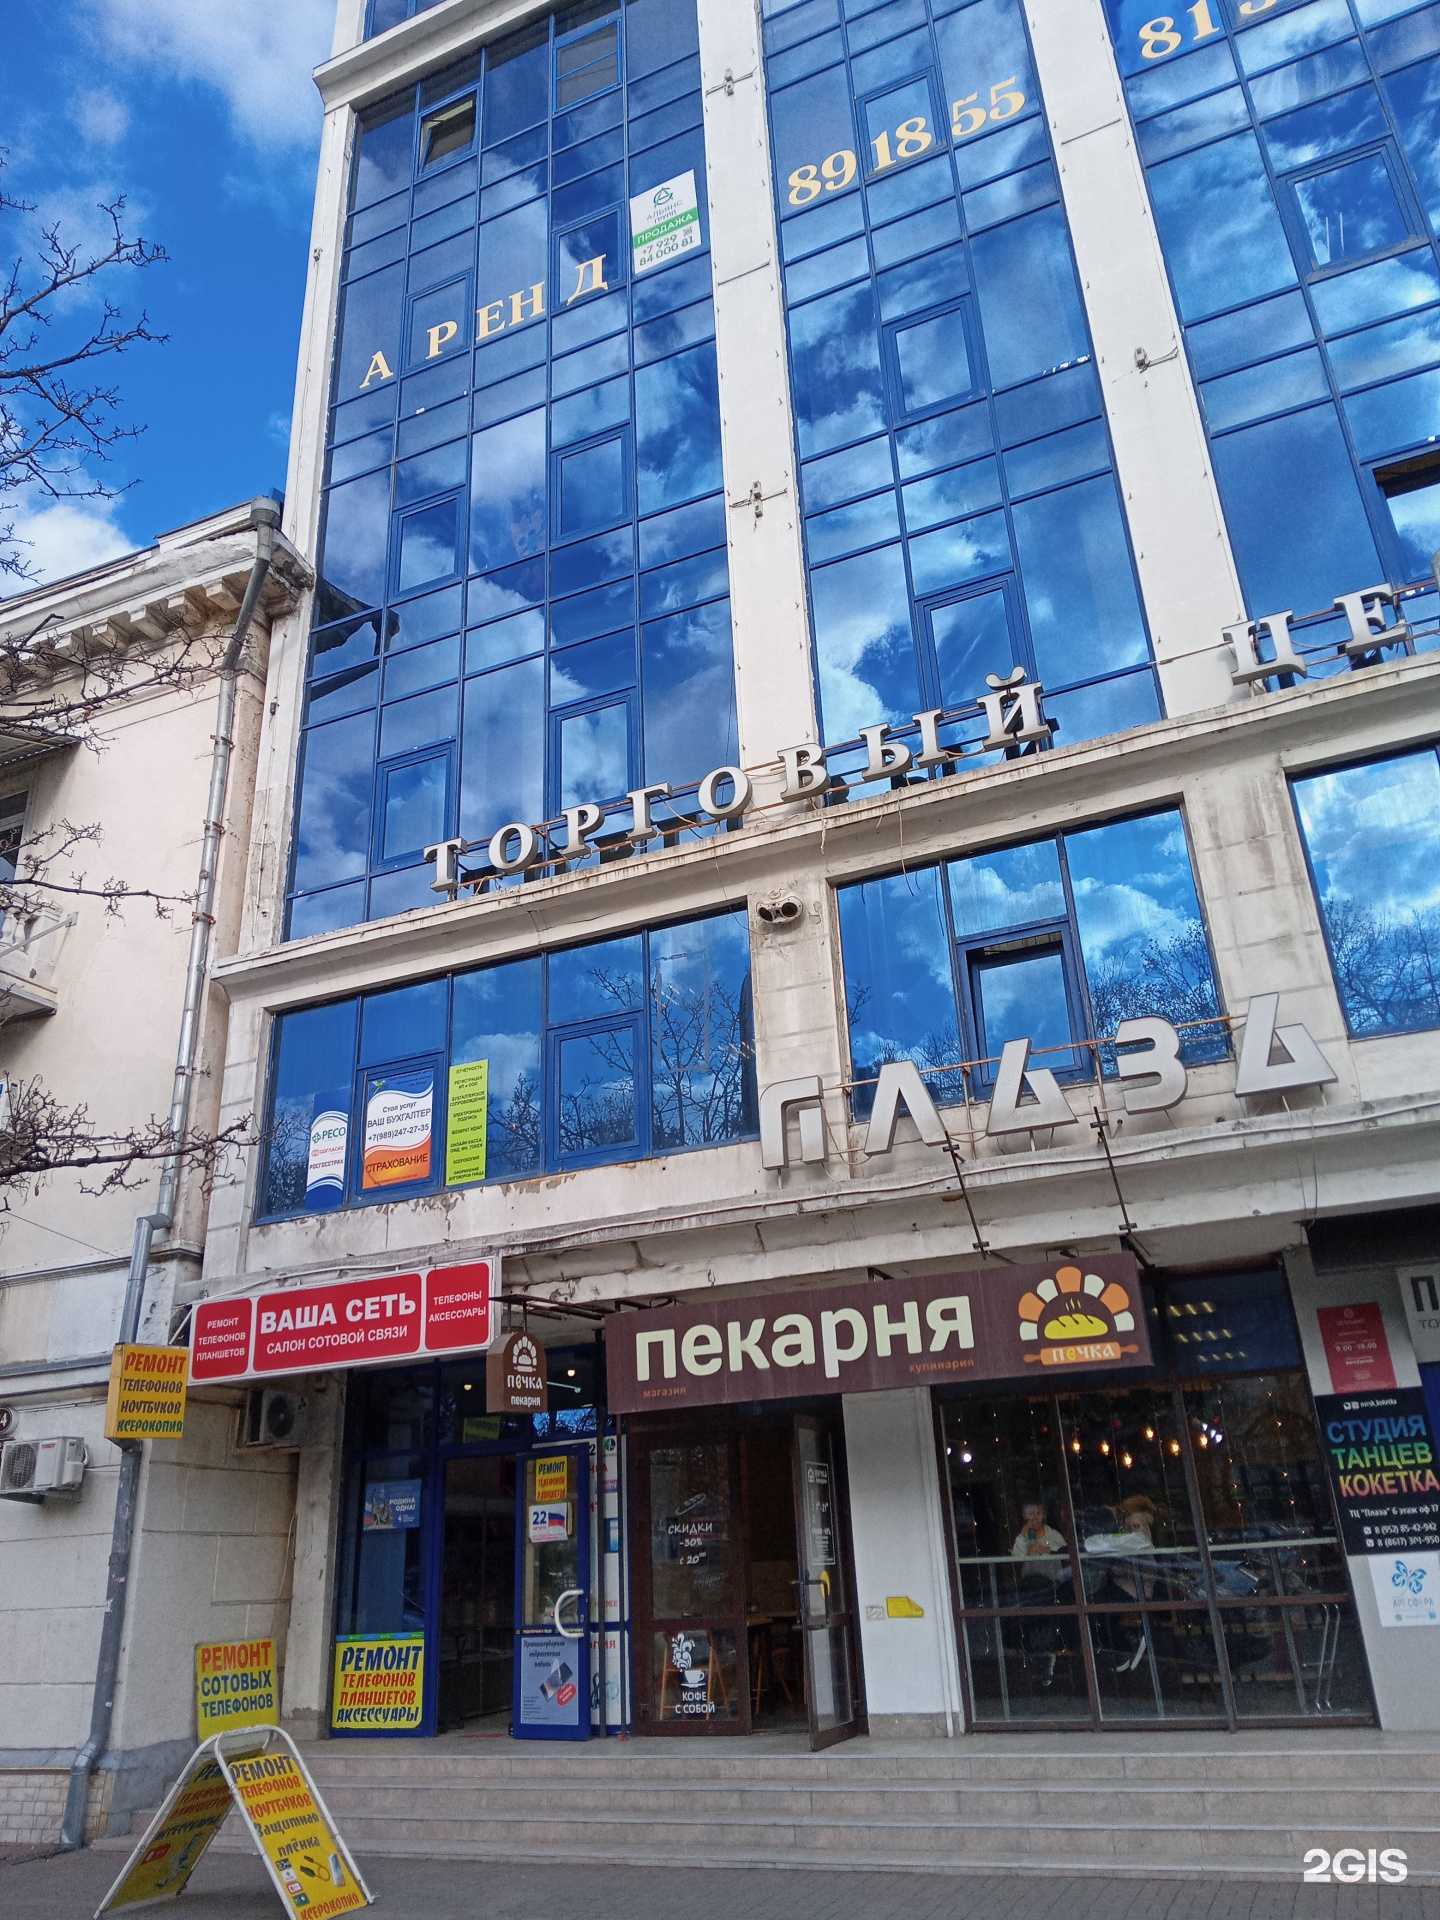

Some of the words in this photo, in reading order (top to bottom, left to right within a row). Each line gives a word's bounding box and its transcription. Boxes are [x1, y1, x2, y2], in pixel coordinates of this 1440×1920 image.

[637, 214, 692, 244] ПРОДАЖА
[656, 243, 678, 259] 000
[657, 234, 677, 248] 929
[424, 666, 1050, 893] ТОРГОВЫЙ
[760, 993, 1338, 1170] ПЛАЗА
[368, 1117, 385, 1128] ВАШ
[386, 1108, 431, 1125] БУХГАЛТЕР
[322, 1126, 346, 1140] РЕСО
[366, 1153, 428, 1173] СТРАХОВАНИЕ
[433, 1290, 482, 1305] ТЕЛЕФОНЫ
[207, 1317, 239, 1329] РЕМОНТ
[260, 1302, 337, 1334] ВАША
[345, 1293, 416, 1322] СЕТЬ
[428, 1306, 486, 1323] АКСЕССУАРЫ
[198, 1332, 246, 1345] ТЕЛЕФОНОВ
[266, 1338, 306, 1354] САЛОН
[308, 1329, 365, 1351] СОТОВОЙ
[368, 1325, 408, 1342] СВЯЗИ
[636, 1295, 975, 1381] пекарня
[125, 1352, 186, 1374] РЕМОНТ
[196, 1348, 245, 1361] ПЛАНШЕТОВ
[123, 1379, 183, 1393] ТЕЛЕФОНОВ
[121, 1400, 181, 1414] НОУТБУКОВ
[117, 1419, 183, 1432] КСЕРОКОПИЯ
[1328, 1415, 1426, 1444] СТУДИЯ
[1331, 1442, 1432, 1470] ТАНЦЕВ
[1339, 1469, 1440, 1497] КОКЕТКА
[533, 1511, 547, 1525] 22
[668, 1522, 713, 1535] СКИДКИ
[201, 1641, 272, 1672] РЕМОНТ
[341, 1645, 422, 1672] РЕМОНТ
[201, 1670, 272, 1696] СОТОВЫХ
[343, 1671, 416, 1688] ТЕЛЕФОНОВ
[201, 1693, 273, 1718] ТЕЛЕФОНОВ
[340, 1690, 416, 1706] ПЛАНШЕТОВ
[682, 1691, 707, 1701] КОФЕ
[336, 1706, 419, 1723] АКСЕССУАРЫ
[683, 1701, 715, 1714] СОБОЙ
[230, 1756, 294, 1784] РЕМОНТ
[239, 1775, 300, 1800] ТЕЛЕФОНОВ
[246, 1793, 312, 1820] НОУТБУКОВ
[254, 1813, 320, 1838] Защитная
[277, 1836, 320, 1857] плёнка
[301, 1892, 360, 1920] КСЕРОКОПИЯ
